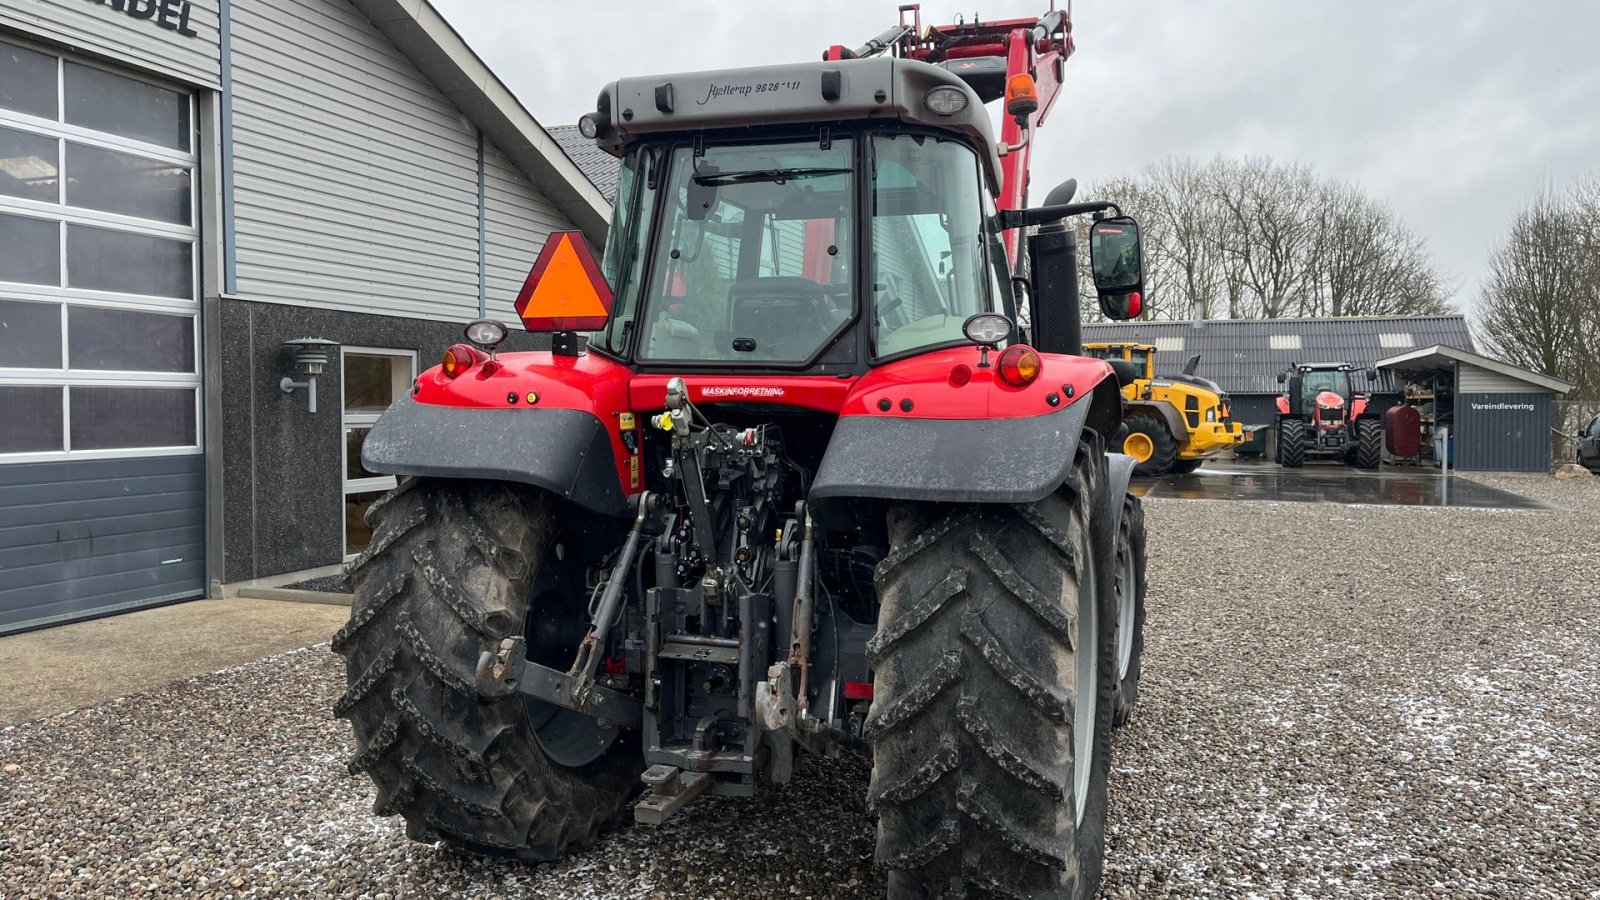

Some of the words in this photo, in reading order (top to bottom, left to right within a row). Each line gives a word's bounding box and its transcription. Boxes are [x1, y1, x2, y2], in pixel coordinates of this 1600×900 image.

[95, 0, 198, 38] DEL
[702, 387, 784, 397] MASKINFORRETNING
[1471, 403, 1534, 411] Vareindlevering
